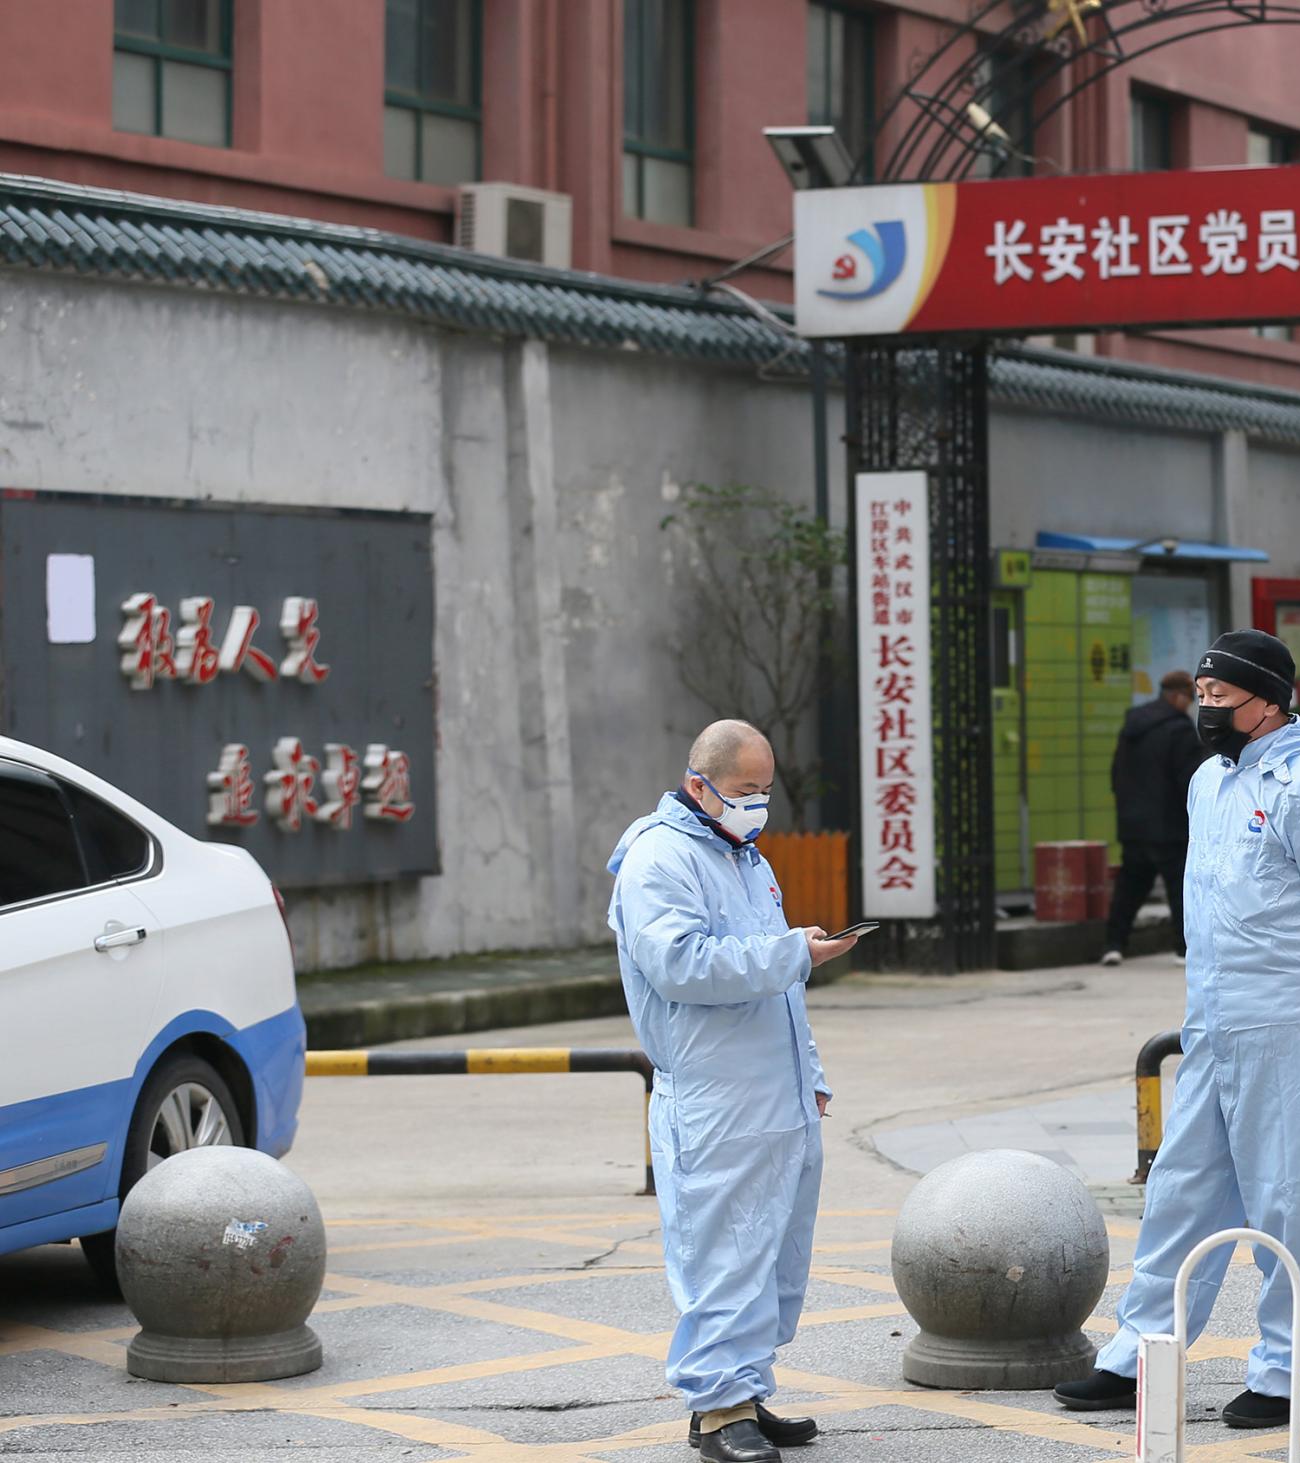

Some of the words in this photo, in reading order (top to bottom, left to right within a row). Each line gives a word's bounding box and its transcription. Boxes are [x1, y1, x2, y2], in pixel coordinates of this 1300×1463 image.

[893, 498, 913, 626] 中共武汉市
[873, 635, 918, 891] 长安社区委员会
